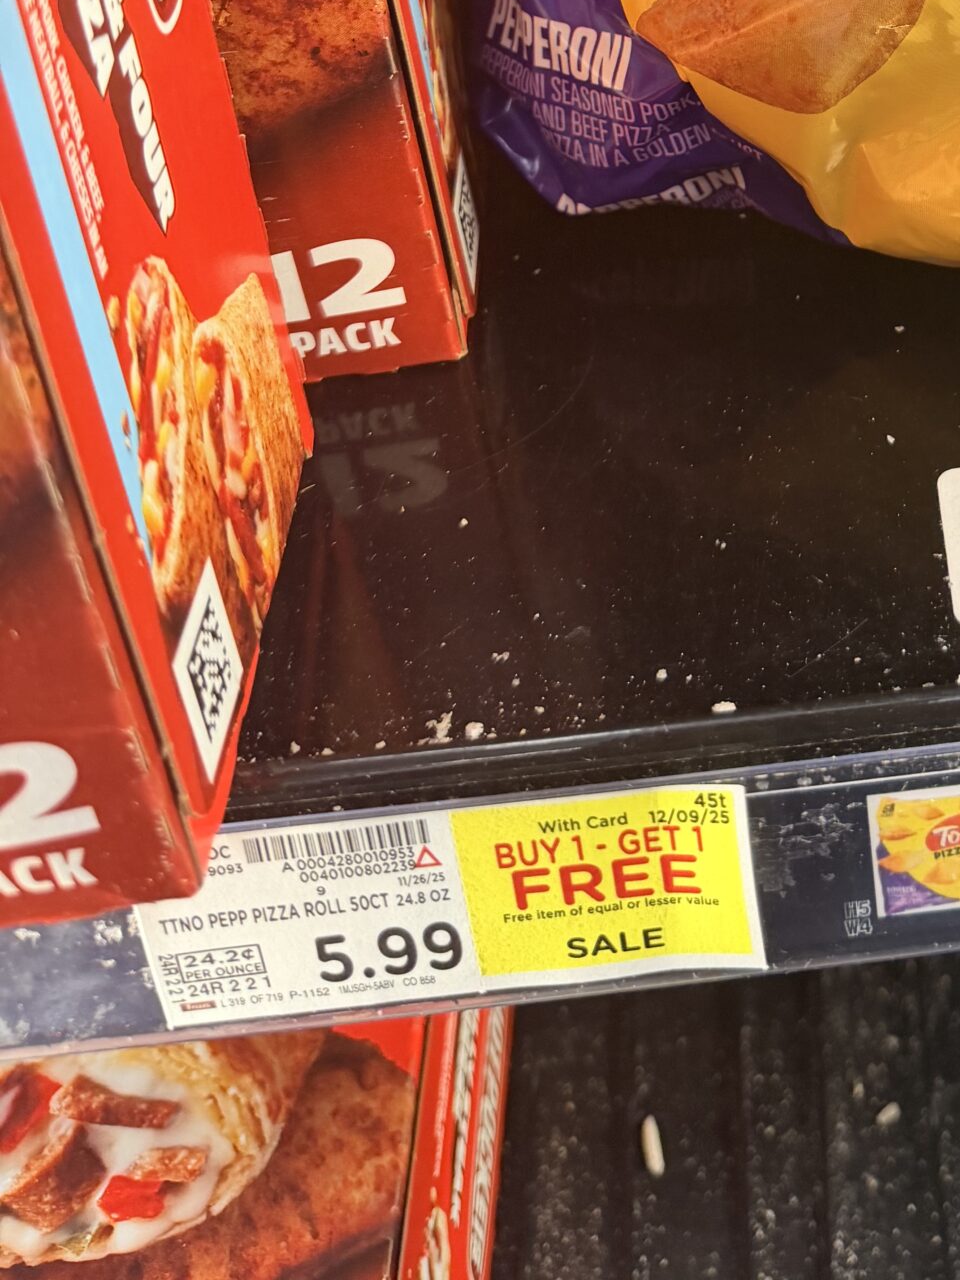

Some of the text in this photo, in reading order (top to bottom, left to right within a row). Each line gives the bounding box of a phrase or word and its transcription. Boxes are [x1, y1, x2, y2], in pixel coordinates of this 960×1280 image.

[551, 76, 635, 123] SEASONED
[119, 34, 175, 232] FOUR
[532, 98, 671, 148] AND BEEF PIZZA
[588, 141, 610, 168] IN
[614, 147, 630, 167] A
[633, 122, 712, 163] GOLDEN
[271, 238, 407, 323] 12
[290, 317, 402, 358] PACK
[538, 809, 730, 834] With Card 12/09/25
[282, 847, 415, 873] A 0004280010953
[494, 837, 560, 869] BUY
[571, 835, 585, 861] 1
[618, 825, 680, 855] GET
[691, 825, 704, 852] 1
[299, 858, 417, 883] 0040100802239
[397, 872, 446, 886] 11/26/25
[511, 854, 701, 910] FREE
[316, 885, 326, 896] 9
[159, 888, 451, 934] TTNO PEPP PIZZA ROLL 50CT 24.8 OZ
[503, 896, 720, 923] Free item of equal or lesser value
[183, 948, 256, 969] 24.2¢
[314, 921, 464, 983] 5.99
[566, 927, 666, 959] SALE
[185, 962, 262, 980] PER OUNCE
[188, 980, 224, 997] 24R
[229, 979, 240, 993] 2
[246, 977, 257, 990] 2
[289, 987, 330, 1000] P-1152
